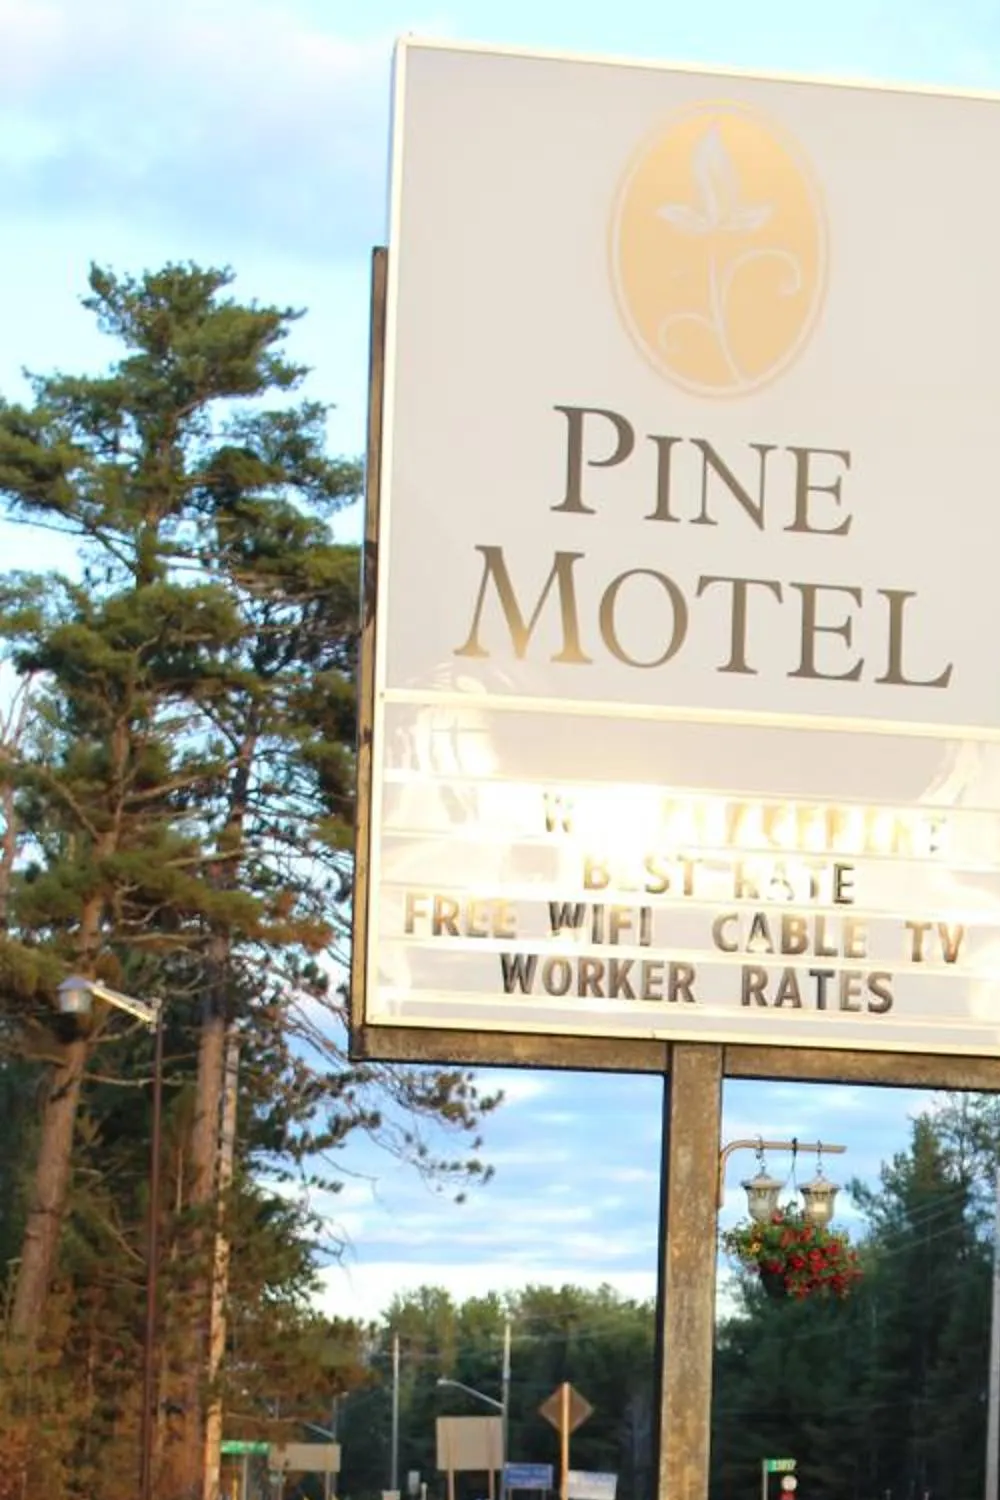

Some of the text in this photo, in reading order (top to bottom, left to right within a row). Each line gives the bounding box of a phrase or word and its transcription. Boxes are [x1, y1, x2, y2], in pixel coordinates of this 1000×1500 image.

[550, 404, 853, 536] PINE
[453, 545, 953, 688] MOTEL
[582, 849, 703, 896] BST
[404, 892, 965, 964] FREE WIFI CABLE TV
[500, 952, 894, 1014] WORKER RATES
